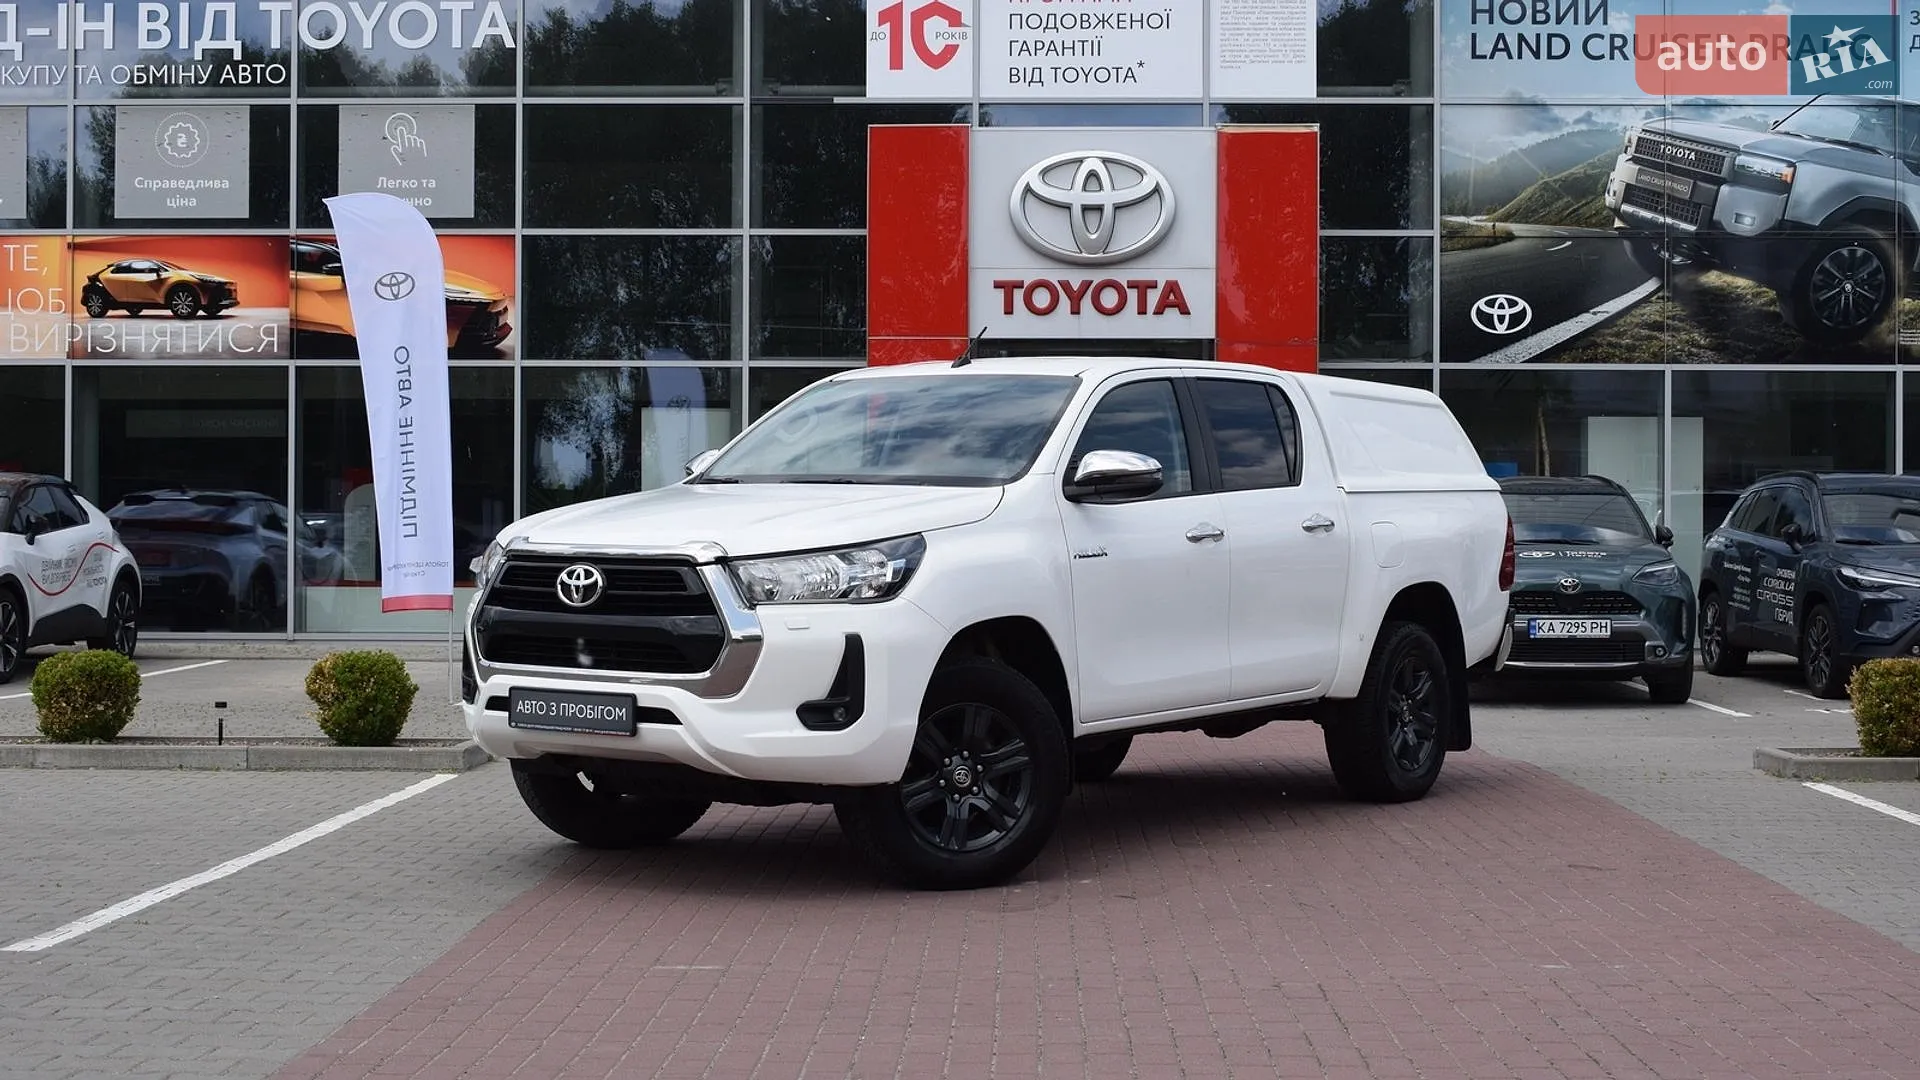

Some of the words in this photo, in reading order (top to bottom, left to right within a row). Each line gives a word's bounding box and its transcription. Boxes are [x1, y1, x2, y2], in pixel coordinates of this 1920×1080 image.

[137, 2, 242, 61] ВІД
[259, 1, 516, 50] TOYOTA
[1009, 9, 1172, 33] ПОДОВЖЕНОЇ
[935, 31, 968, 40] РОКІВ
[1009, 36, 1103, 56] ГАРАНТІЇ
[1471, 33, 1570, 60] LAND
[2, 65, 67, 85] КУПУ
[74, 65, 103, 85] ТА
[111, 64, 213, 85] ОБМІНУ
[219, 63, 286, 85] АВТО
[1009, 67, 1044, 87] ВІД
[1660, 144, 1696, 161] TOYOTA
[134, 176, 230, 192] Справедлива
[377, 176, 418, 189] Легко
[421, 179, 437, 188] та
[166, 194, 198, 209] ціна
[993, 279, 1191, 316] TOYOTA
[11, 323, 278, 353] ВИРІЗНЯТИСЯ
[1756, 589, 1794, 607] CROSS
[1537, 621, 1556, 634] KA
[1560, 621, 1588, 634] 7295
[1590, 621, 1608, 634] PH
[516, 700, 546, 715] АВТО
[560, 703, 627, 721] ПРОБІГОМ
